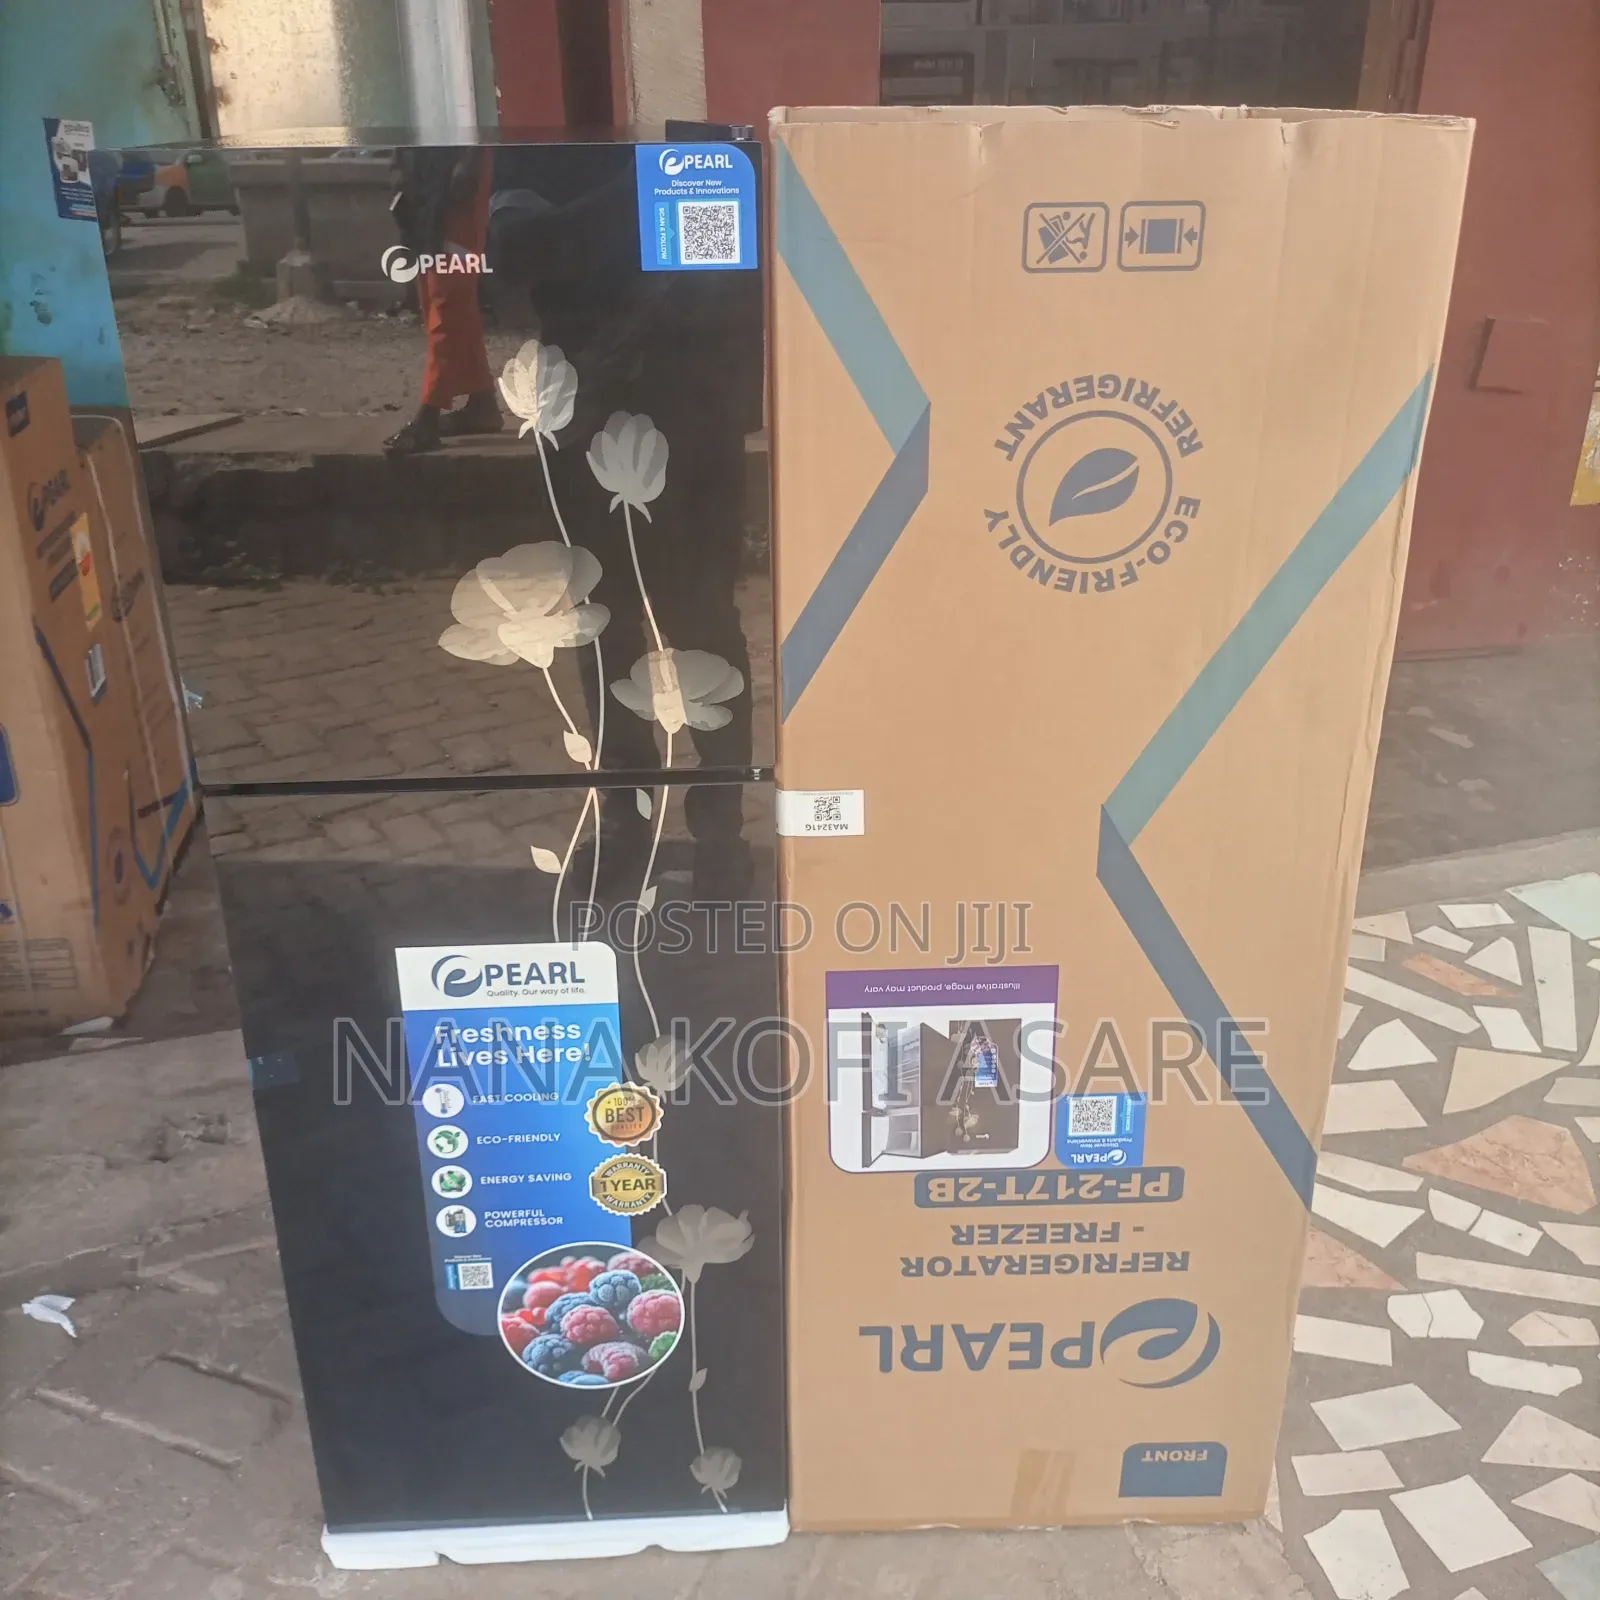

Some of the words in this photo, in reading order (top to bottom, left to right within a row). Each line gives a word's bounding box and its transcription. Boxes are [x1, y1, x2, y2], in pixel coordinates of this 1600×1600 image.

[684, 154, 733, 169] PEARL
[671, 179, 704, 187] Discover
[705, 179, 722, 187] New
[654, 188, 688, 196] Products
[696, 187, 739, 195] Innovations
[419, 253, 494, 274] PEARL
[994, 374, 1203, 462] REFRIGERANT
[983, 496, 1201, 594] ECO-FRIENDLY
[805, 823, 849, 831] MA3241G
[485, 961, 586, 986] PEARL
[486, 989, 520, 998] Quality.
[522, 988, 538, 996] Our
[540, 988, 558, 997] way
[560, 987, 570, 995] of
[864, 985, 884, 993] vary
[885, 984, 906, 993] may
[907, 983, 942, 993] product
[944, 982, 974, 991] image,
[976, 982, 1021, 991] Illustrative
[435, 1023, 581, 1045] Freshness
[437, 1046, 509, 1067] Lives
[517, 1043, 592, 1064] Here!
[473, 1093, 502, 1104] FAST
[504, 1092, 559, 1103] COOLING
[605, 1106, 645, 1123] BEST
[476, 1133, 561, 1145] ECO-FRIENDLY
[1070, 1153, 1108, 1164] PEARL
[605, 1162, 650, 1177] WARRANTY
[480, 1174, 525, 1185] ENERGY
[528, 1173, 572, 1183] SAVING
[600, 1180, 607, 1192] 1
[610, 1178, 656, 1191] YEAR
[928, 1172, 1170, 1202] PF-217T-2B
[605, 1194, 652, 1208] WARRANTY
[485, 1209, 545, 1219] POWERFUL
[485, 1217, 563, 1228] COMPRESSOR
[950, 1221, 1120, 1246] FREEZER
[900, 1251, 1190, 1277] REFRIGERATOR
[859, 1320, 1096, 1374] PEARL
[1141, 1449, 1208, 1462] FRONT
